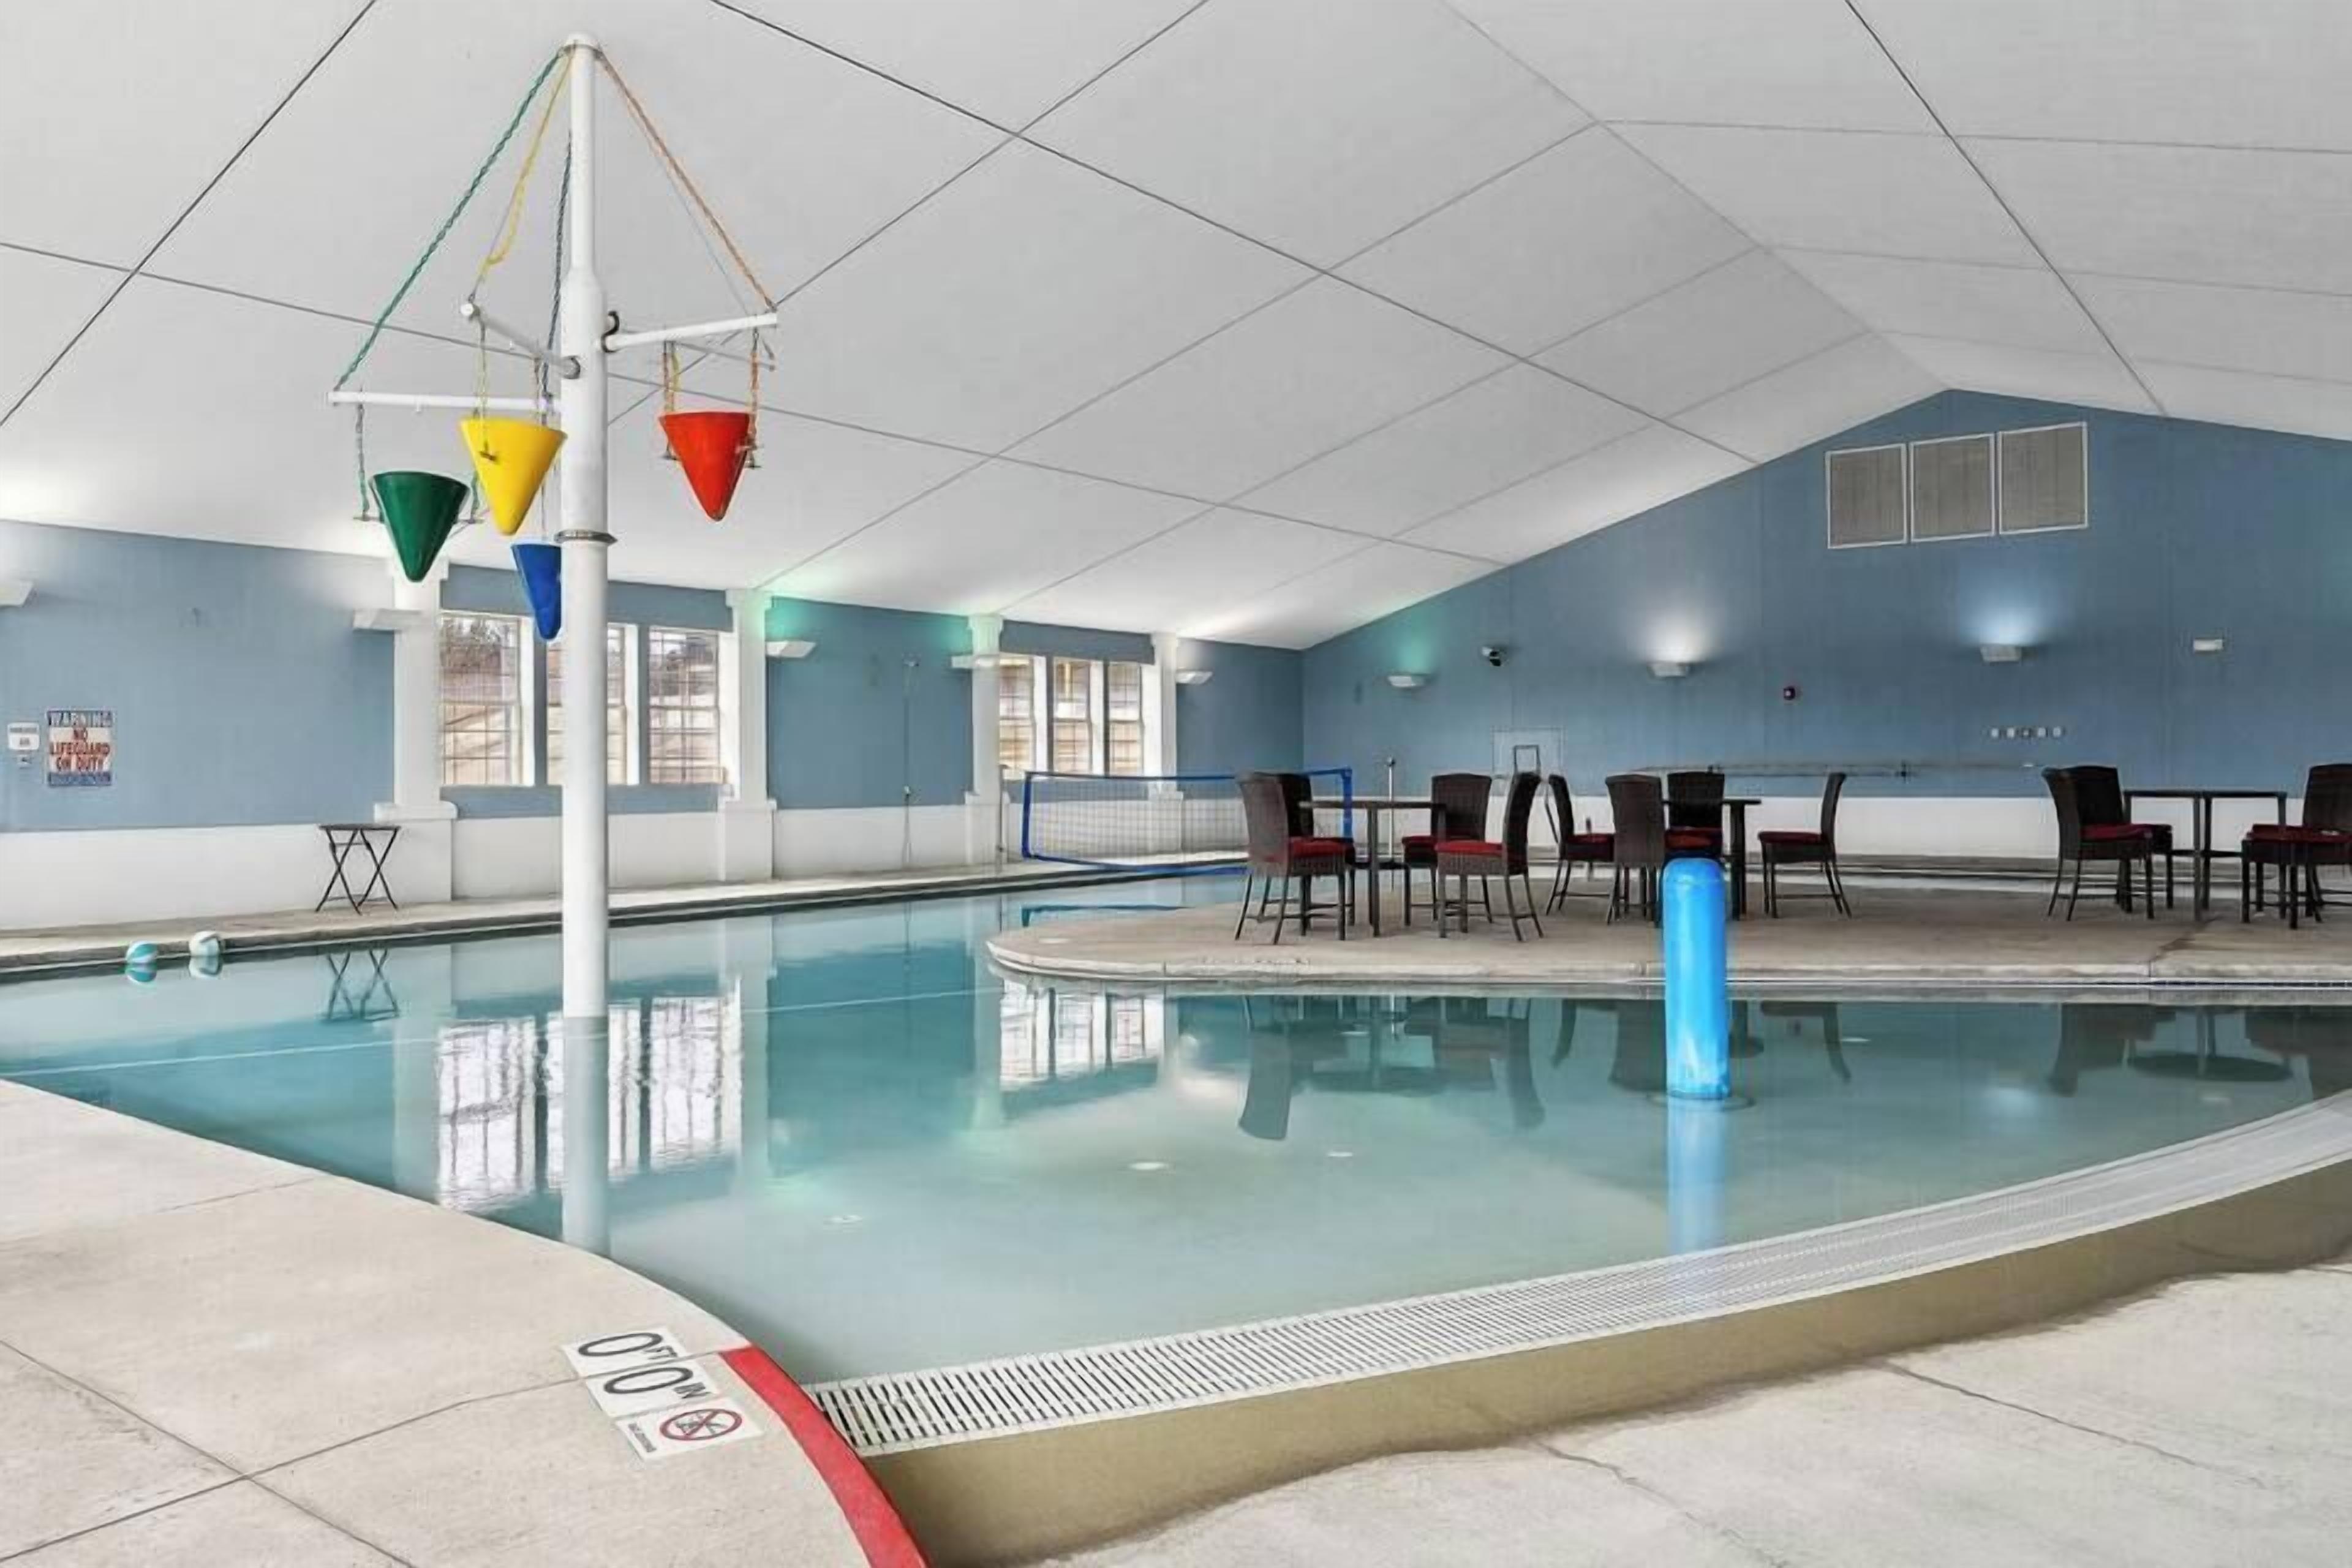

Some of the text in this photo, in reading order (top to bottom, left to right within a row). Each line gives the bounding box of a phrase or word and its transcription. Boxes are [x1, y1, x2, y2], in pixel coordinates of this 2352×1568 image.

[74, 728, 88, 740] NO
[50, 742, 110, 755] LIFEGUARD
[56, 756, 105, 771] ON DUTY
